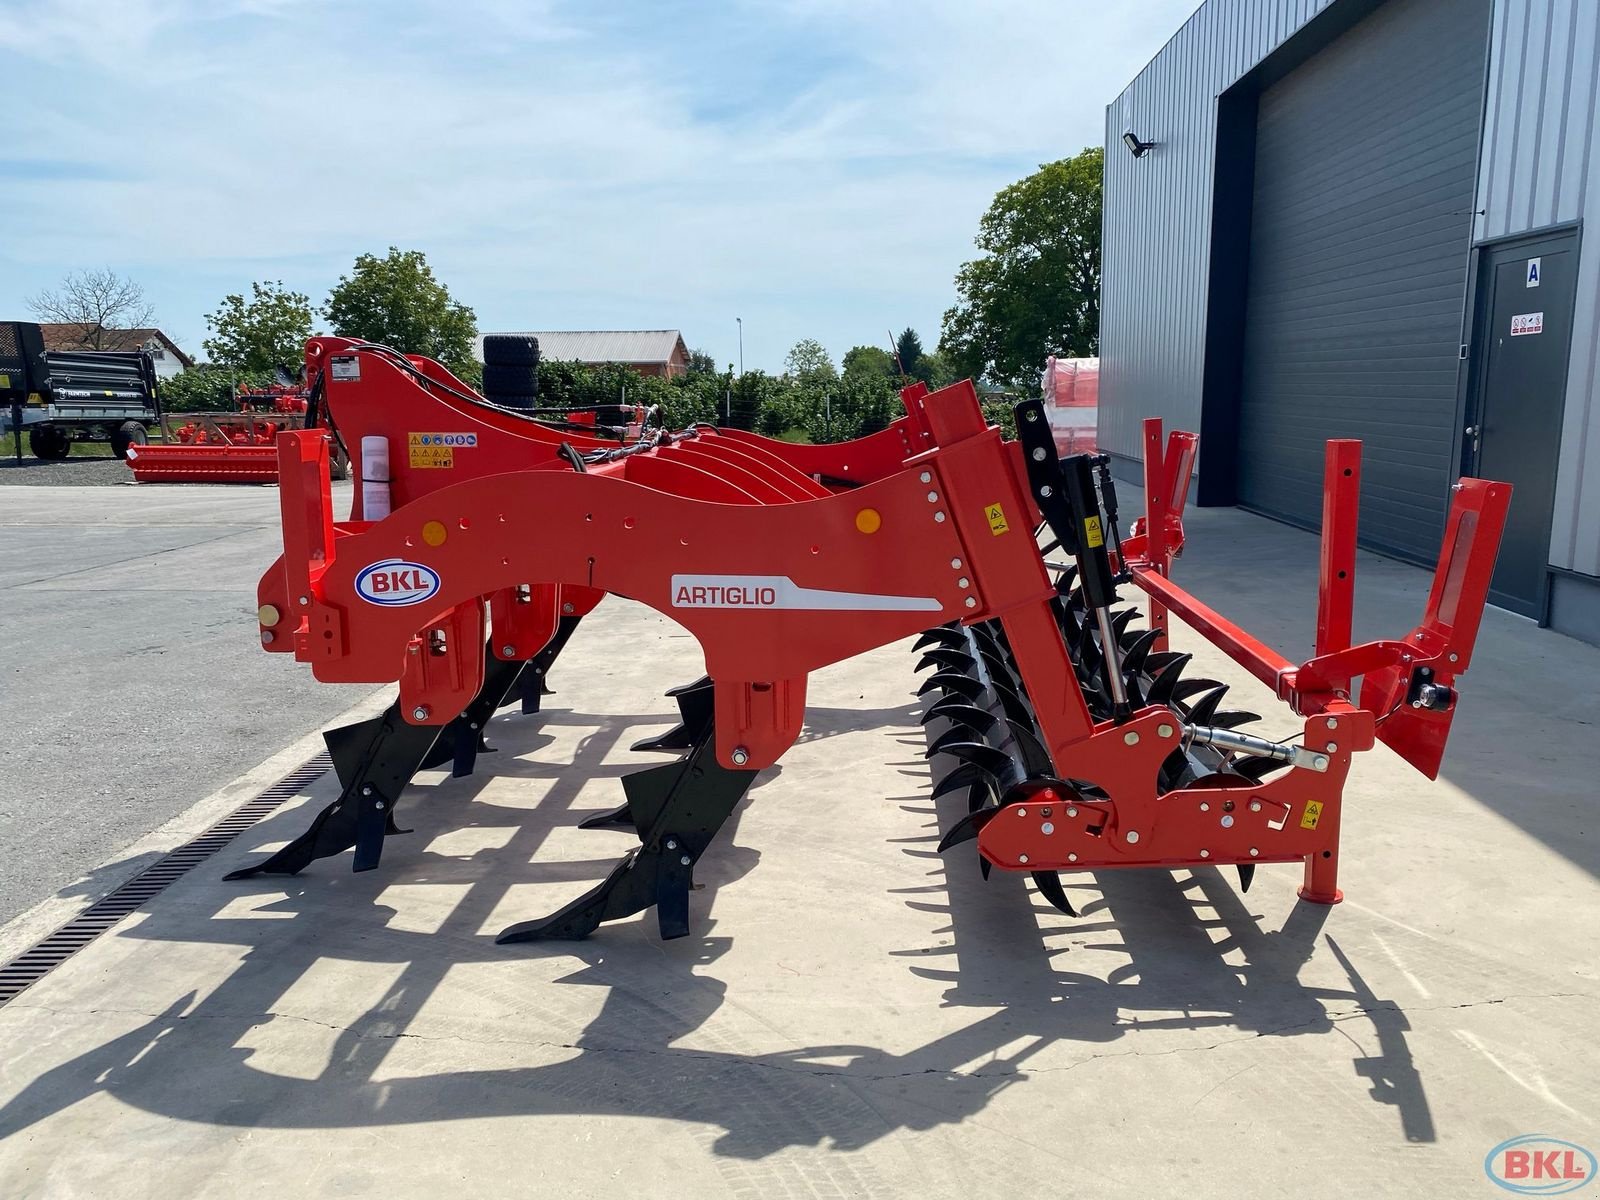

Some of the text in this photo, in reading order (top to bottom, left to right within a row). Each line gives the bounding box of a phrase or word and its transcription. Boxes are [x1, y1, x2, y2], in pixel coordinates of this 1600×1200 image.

[1528, 263, 1539, 282] A
[371, 570, 429, 593] BKL
[676, 586, 776, 605] ARTIGLIO
